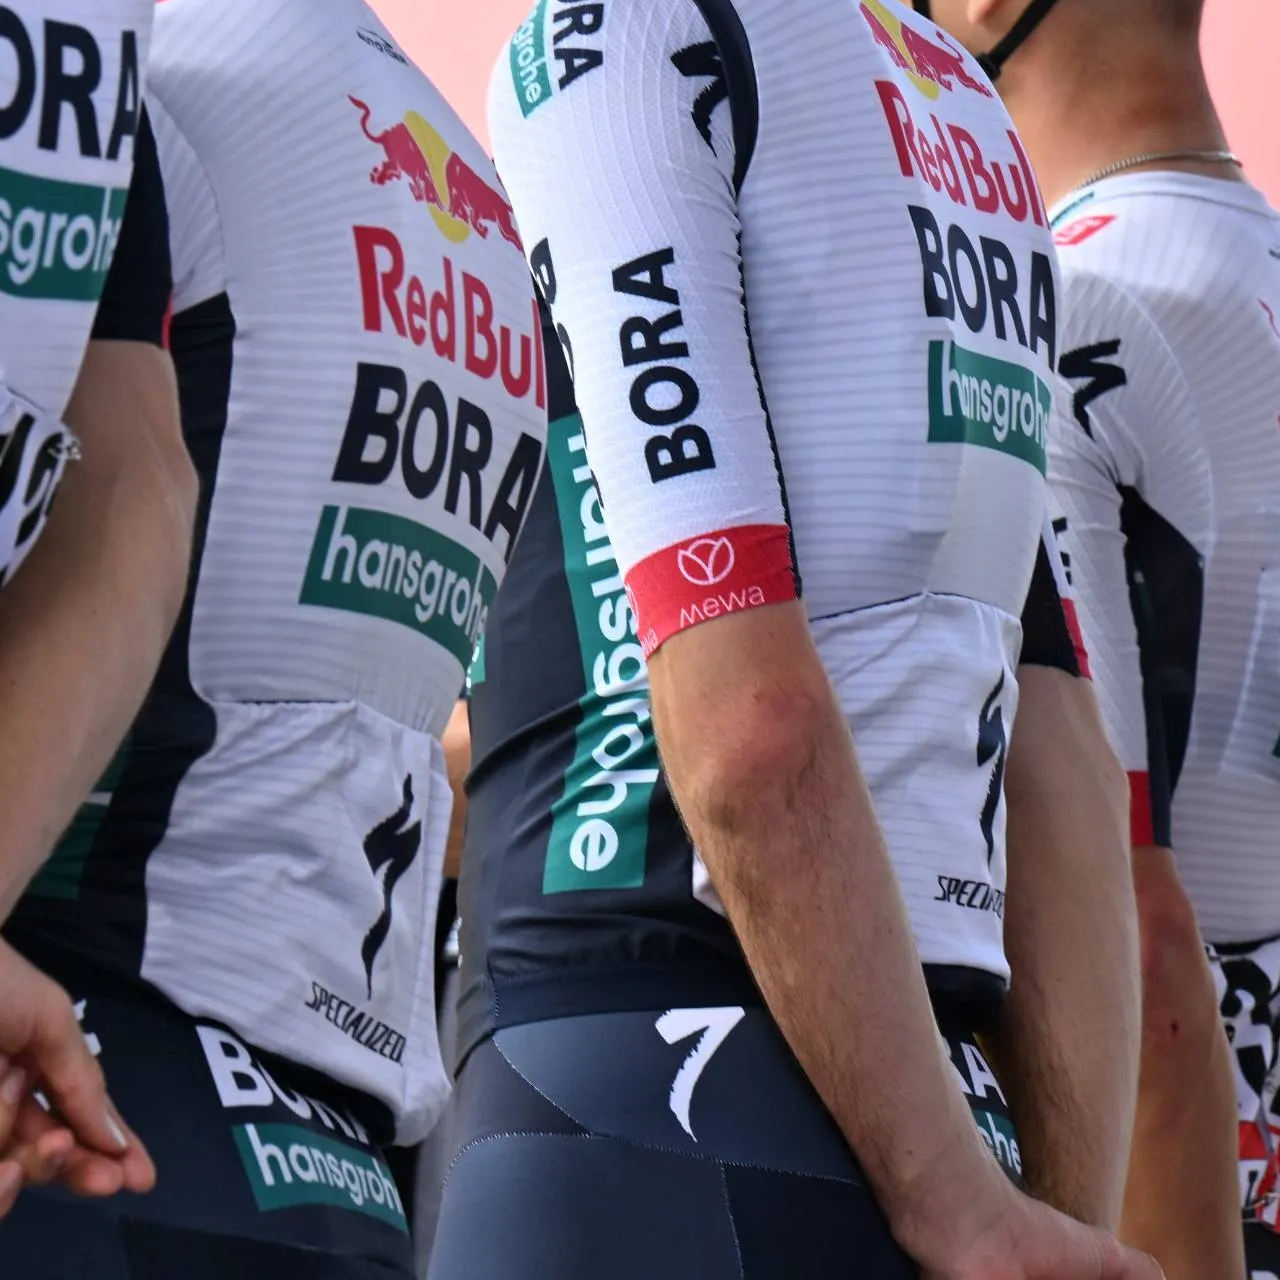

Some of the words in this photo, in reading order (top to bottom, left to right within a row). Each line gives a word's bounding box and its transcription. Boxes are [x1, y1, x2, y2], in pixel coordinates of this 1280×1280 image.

[513, 10, 546, 104] grohe
[907, 205, 1058, 375] BORA
[612, 246, 716, 484] BORA
[332, 362, 542, 564] BORA
[678, 585, 766, 629] mewa
[304, 980, 407, 1065] SPECIALIZED
[244, 1122, 404, 1216] hansgroh
